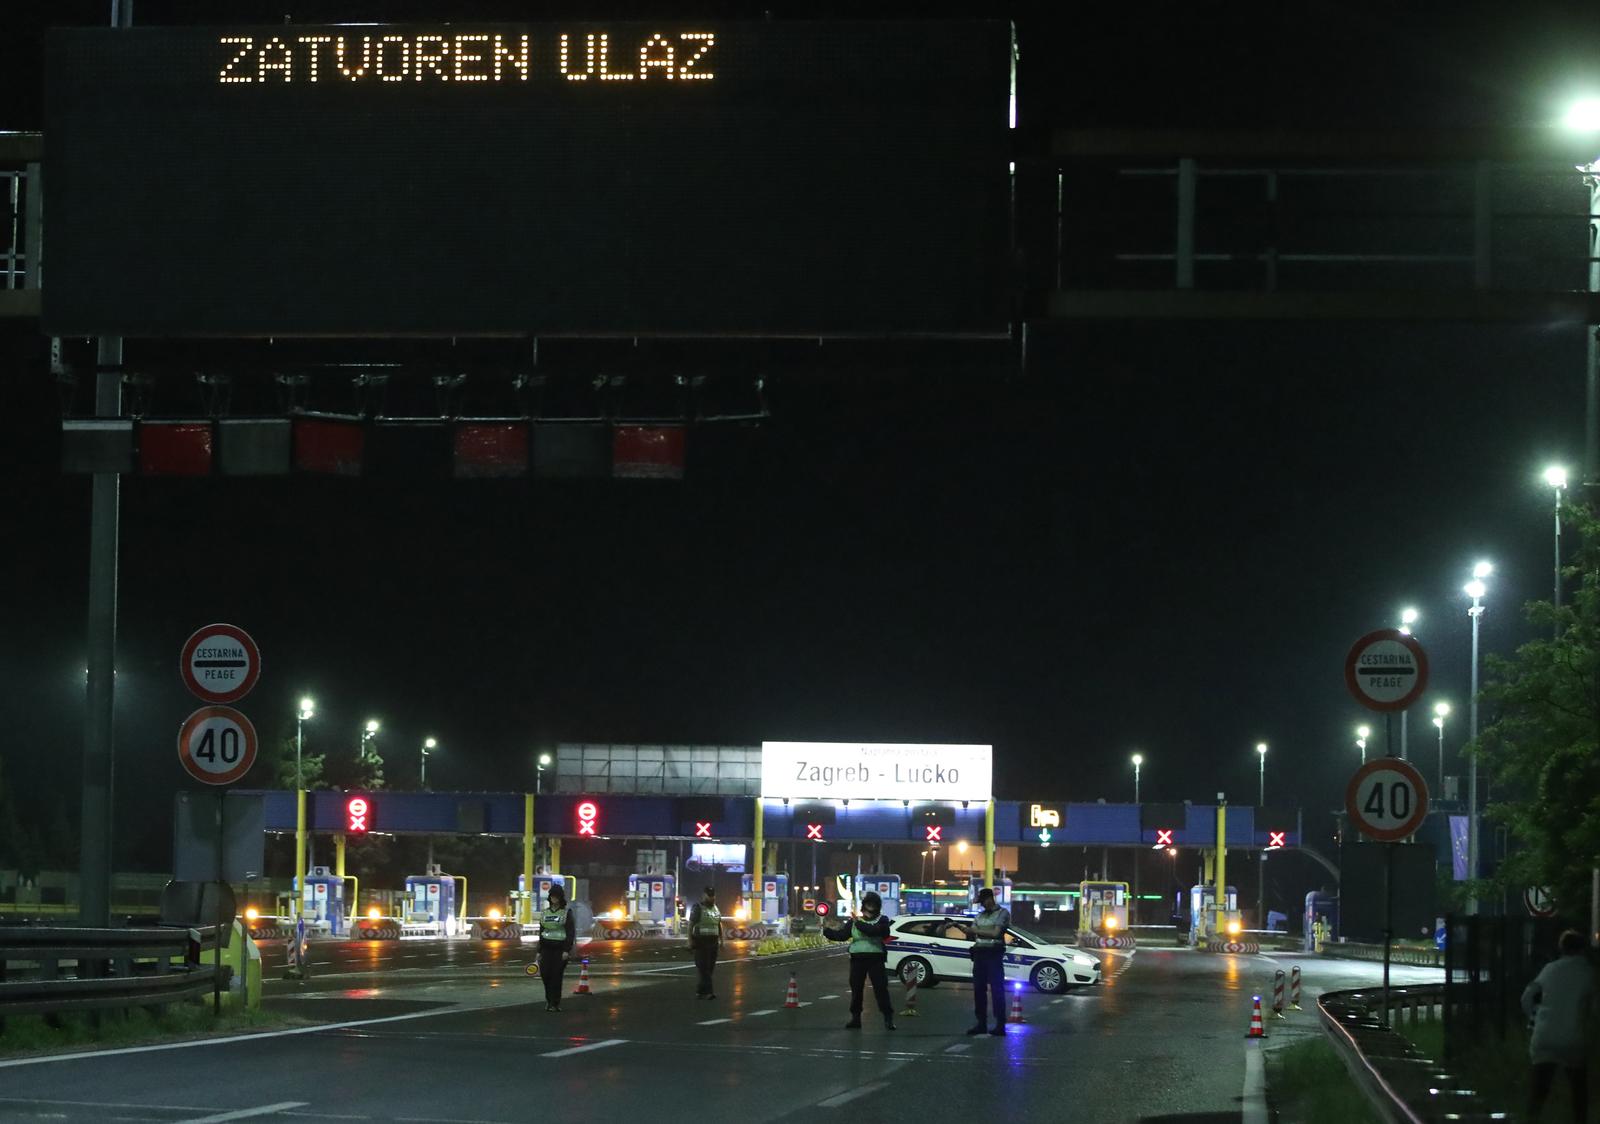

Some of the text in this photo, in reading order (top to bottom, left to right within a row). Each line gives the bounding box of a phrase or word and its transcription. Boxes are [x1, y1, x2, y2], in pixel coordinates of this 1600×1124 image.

[219, 32, 716, 83] ZATVOREN ULAZ
[196, 648, 244, 658] CESTARINA
[1361, 654, 1411, 665] CESTARINA
[205, 669, 235, 680] PEAGE
[1370, 676, 1402, 688] PEAGE
[196, 727, 239, 764] 40
[796, 761, 870, 787] Zagreb
[895, 763, 960, 784] Lučko
[1364, 782, 1410, 820] 40
